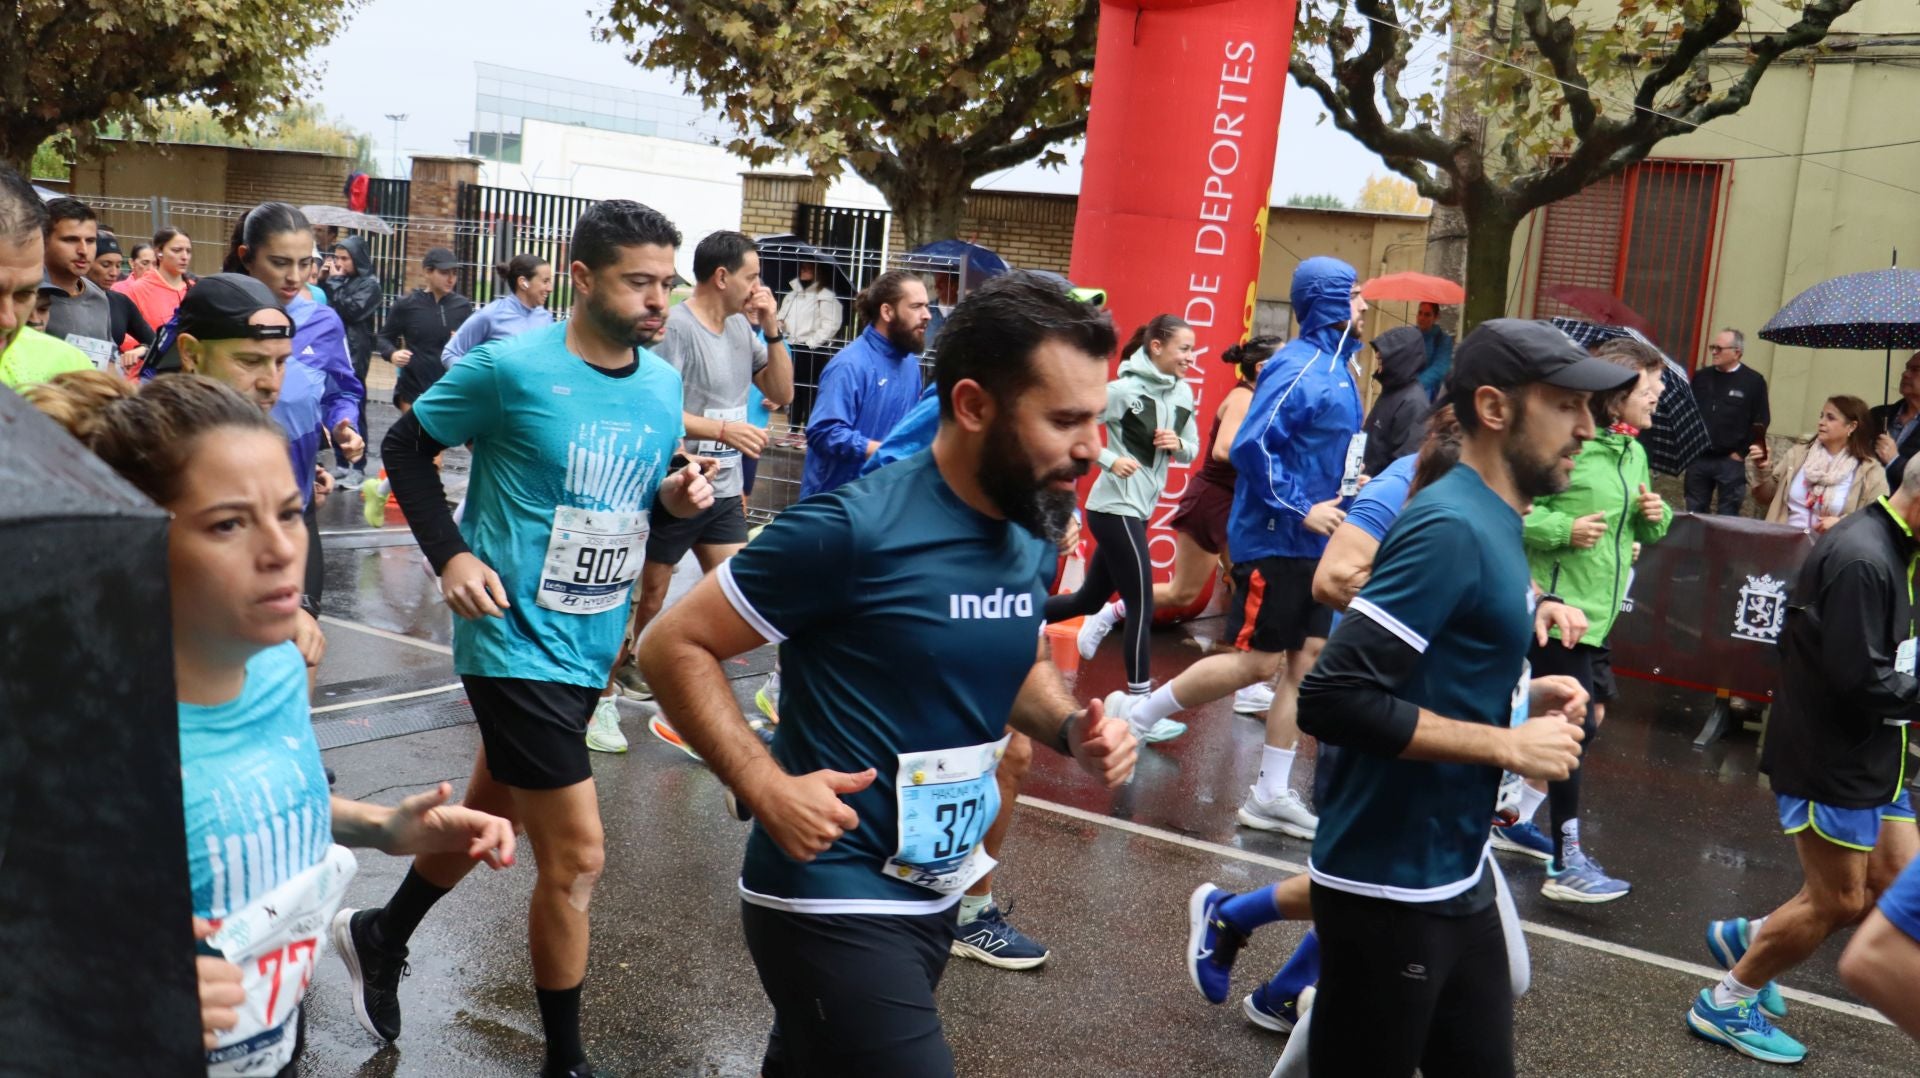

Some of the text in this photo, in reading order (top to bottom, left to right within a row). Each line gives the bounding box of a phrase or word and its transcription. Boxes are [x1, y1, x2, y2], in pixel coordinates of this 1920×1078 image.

[1195, 41, 1255, 256] DEPORTES
[1184, 273, 1220, 328] DE
[573, 547, 629, 584] 902
[949, 587, 1034, 619] indra
